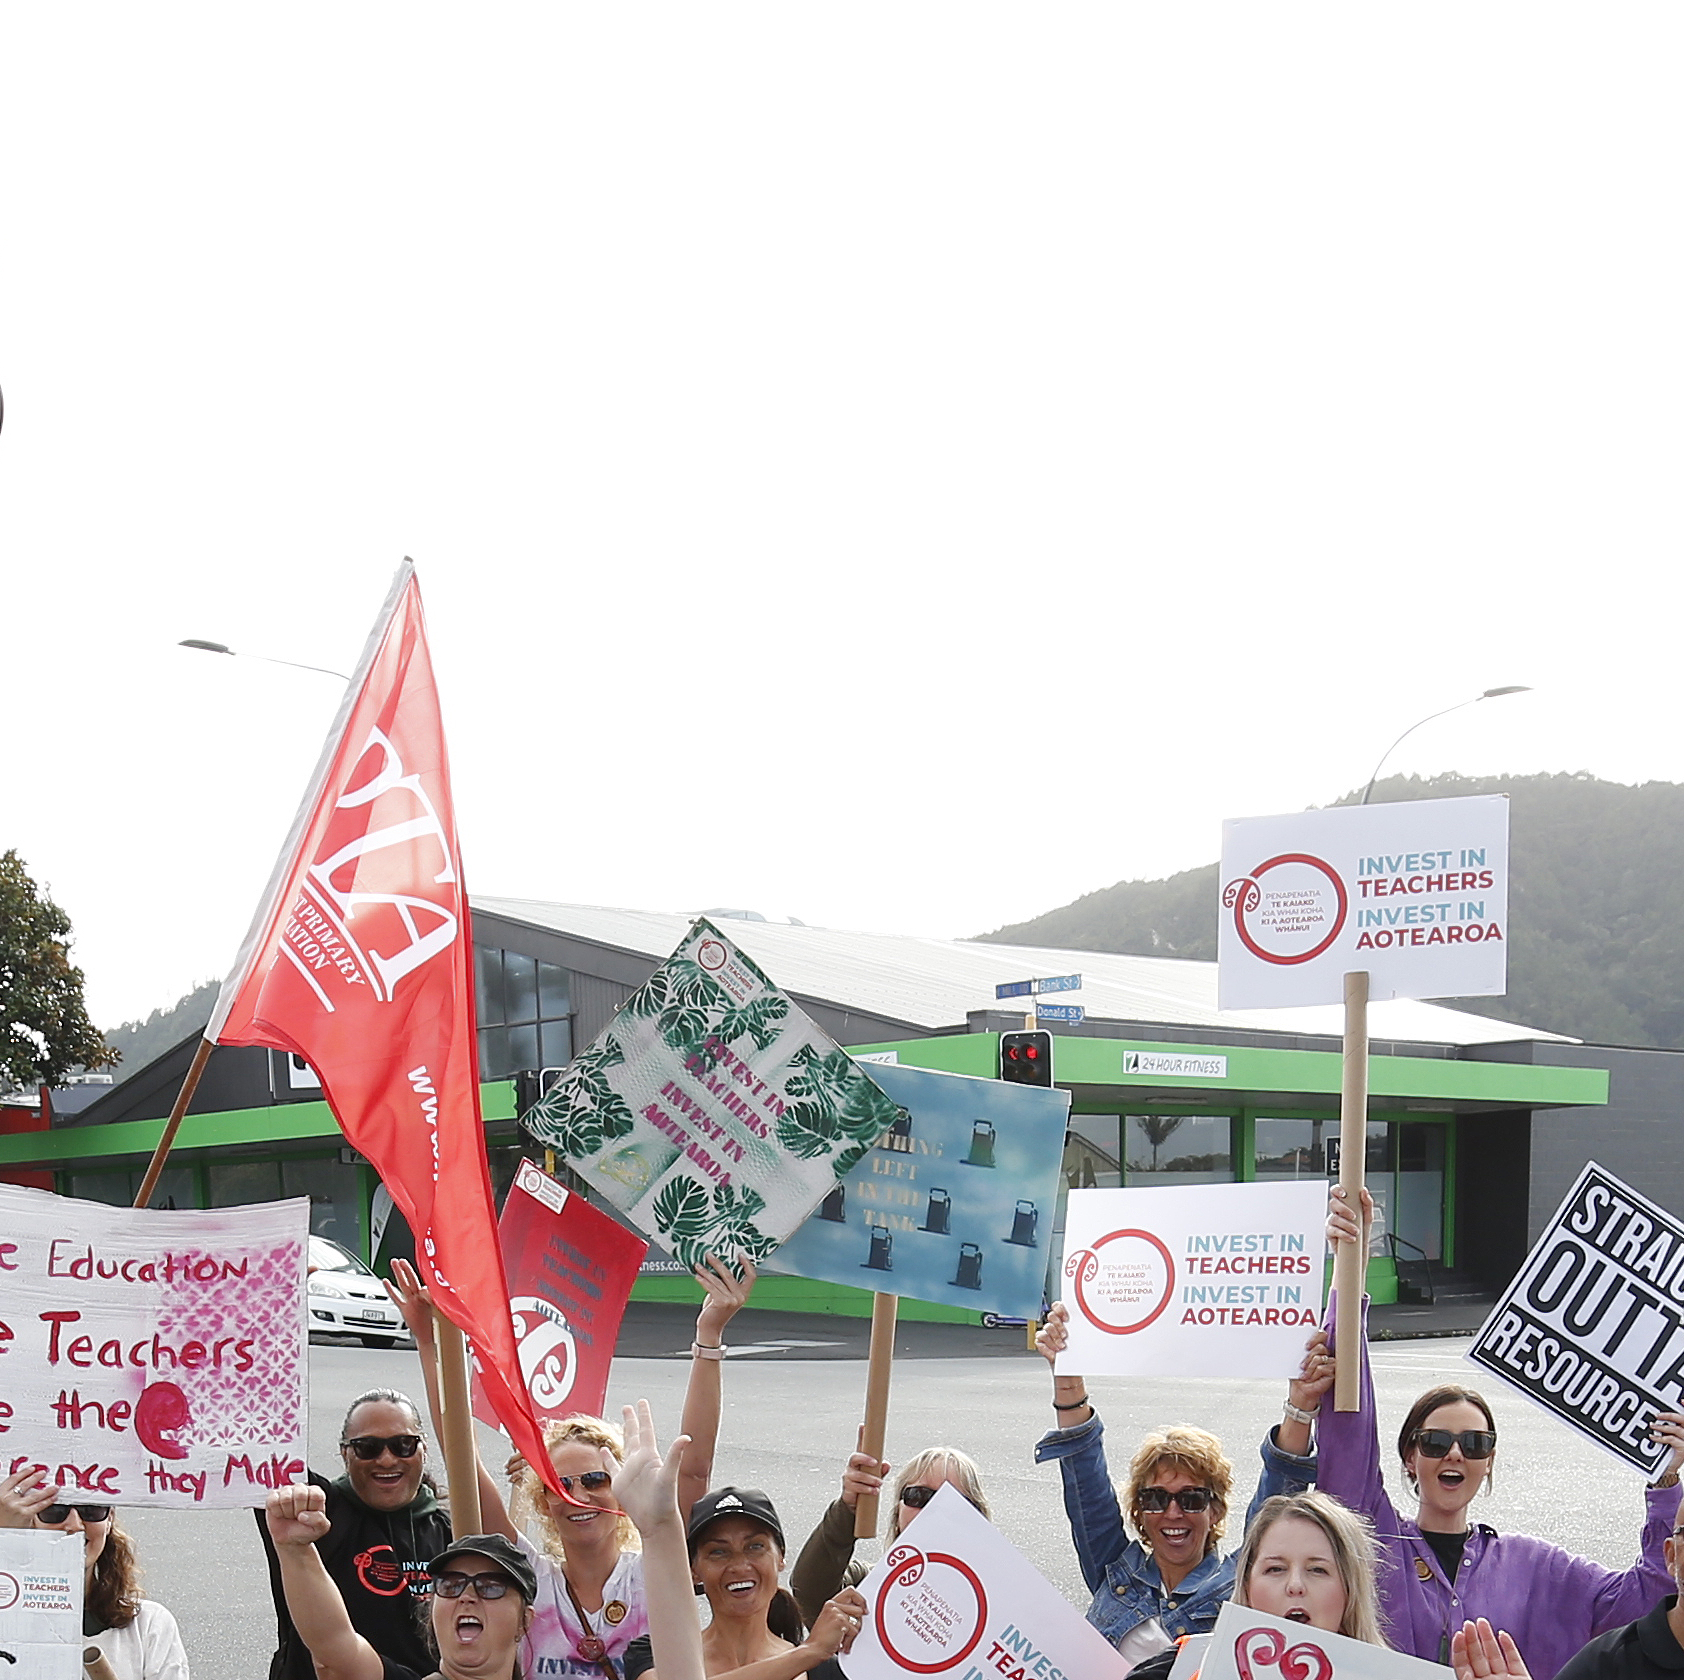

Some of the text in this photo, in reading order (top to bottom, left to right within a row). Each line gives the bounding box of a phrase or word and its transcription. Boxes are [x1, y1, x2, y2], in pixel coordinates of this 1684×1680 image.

[1358, 847, 1487, 876] INVEST IN
[1357, 870, 1494, 898] TEACHERS
[1356, 899, 1485, 928] INVEST IN
[299, 904, 366, 985] PRIMARY
[1355, 921, 1503, 951] AOTEAROA
[1039, 980, 1060, 993] Bank
[1063, 977, 1073, 989] St
[1037, 1006, 1077, 1018] Donald St
[703, 1035, 788, 1117] INVEST IN
[1142, 1057, 1221, 1074] 24 HOUR FITNESS
[685, 1053, 773, 1139] TEACHERS
[661, 1081, 746, 1163] INVEST IN
[640, 1103, 732, 1188] AOTEAROA
[872, 1157, 918, 1180] LEFT
[858, 1181, 920, 1207] IN THE
[863, 1209, 916, 1232] TANK
[1186, 1233, 1305, 1254] INVEST IN
[48, 1239, 247, 1282] Education
[1185, 1255, 1312, 1276] TEACHERS
[1183, 1284, 1301, 1305] INVEST IN
[1180, 1306, 1318, 1328] AOTEAROA
[39, 1311, 254, 1372] Teachers
[51, 1390, 132, 1432] the
[144, 1460, 206, 1501] they
[23, 1584, 70, 1592] TEACHERS
[24, 1576, 56, 1584] INVEST
[22, 1602, 73, 1610] AOTEAROA
[23, 1594, 56, 1602] INVEST
